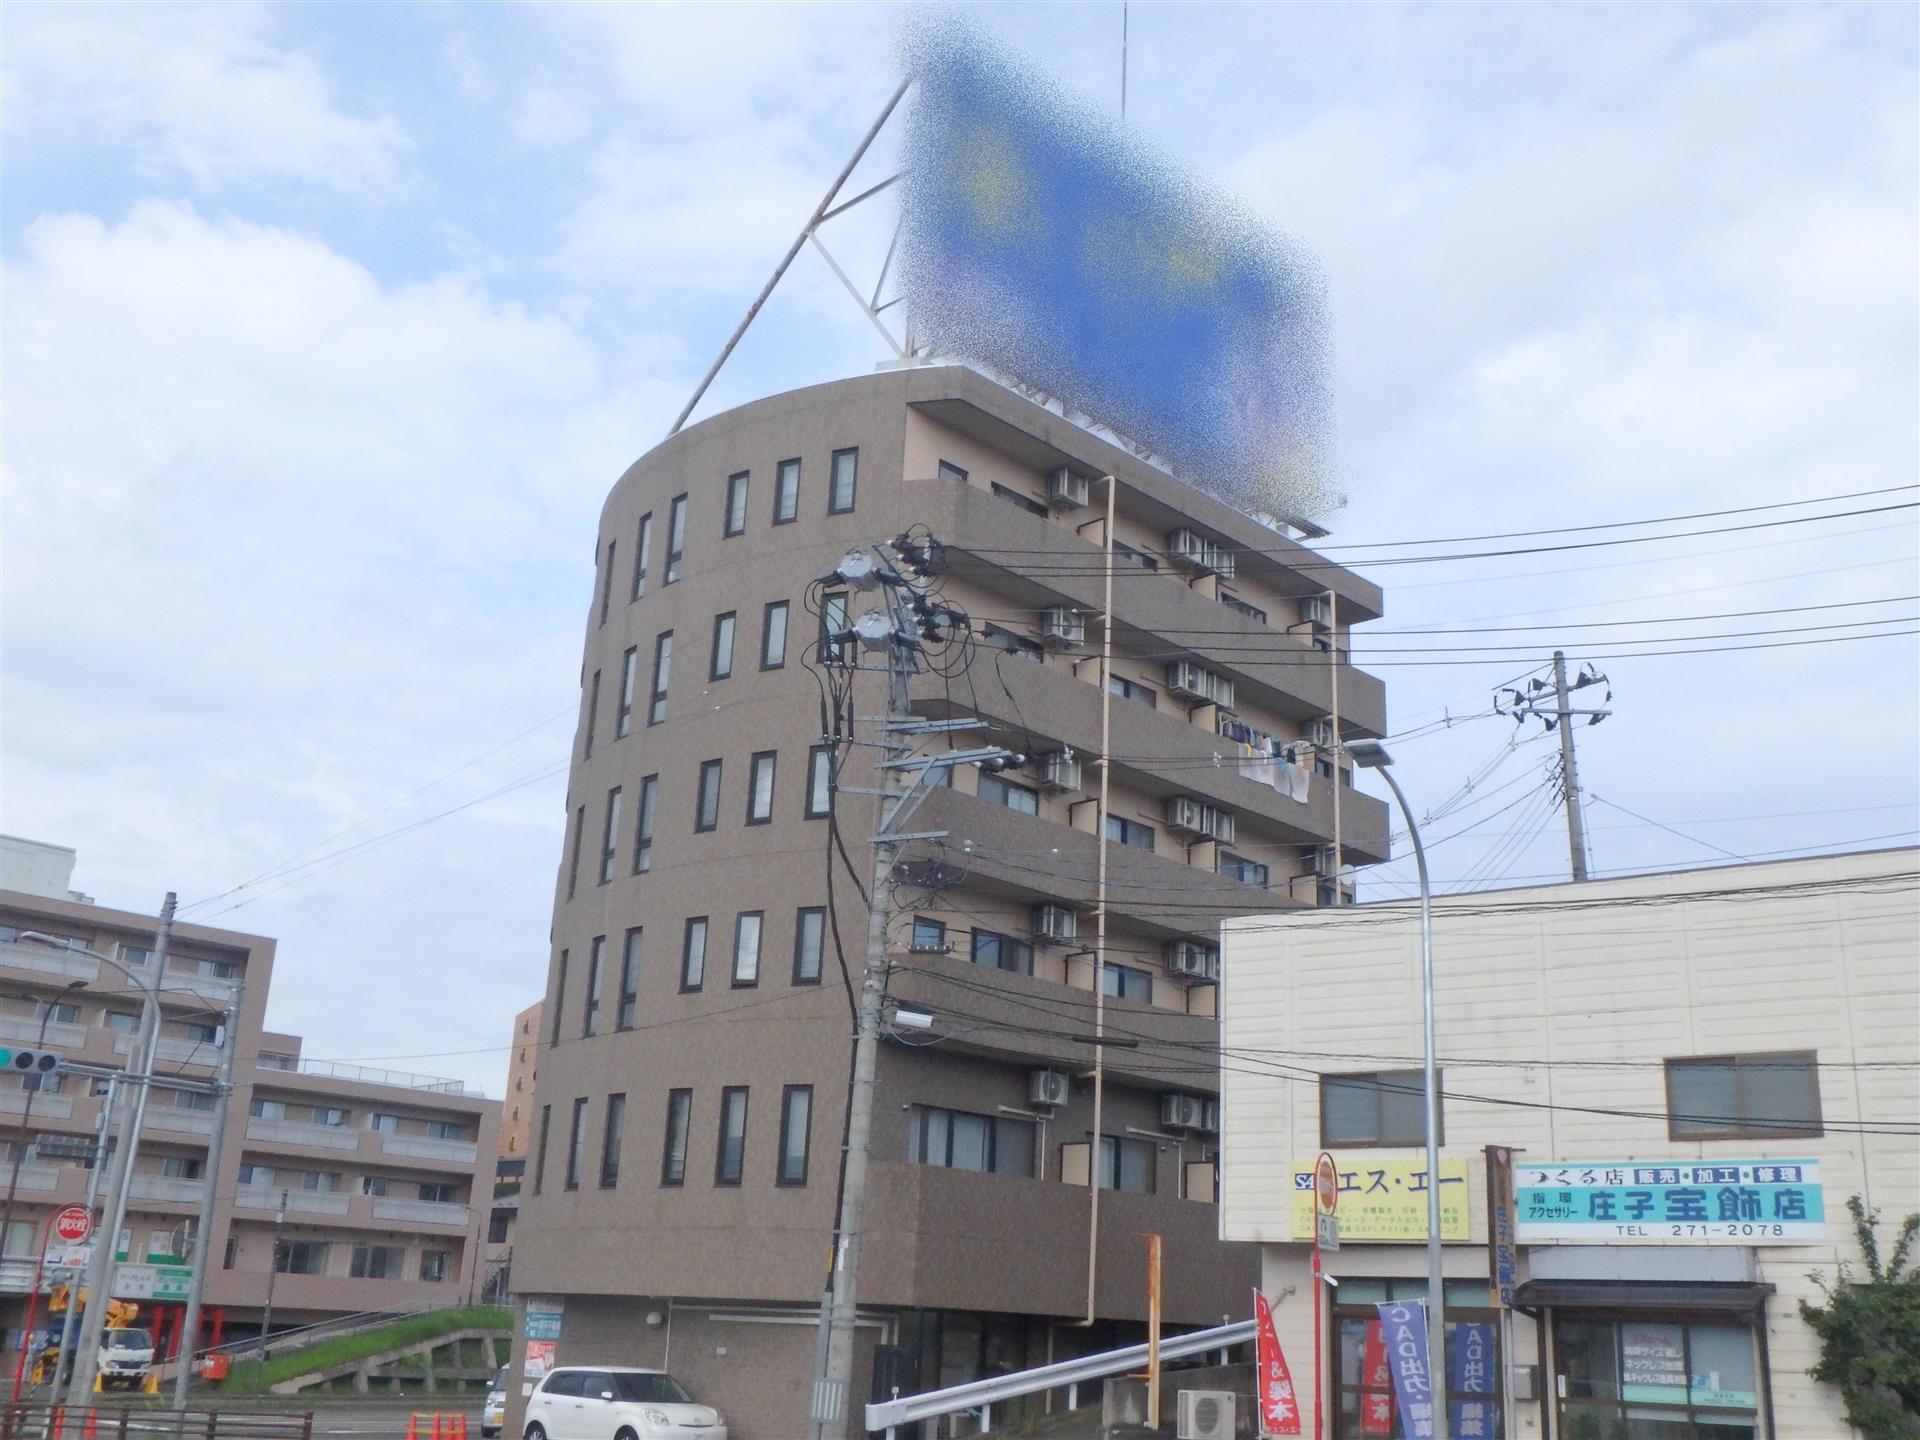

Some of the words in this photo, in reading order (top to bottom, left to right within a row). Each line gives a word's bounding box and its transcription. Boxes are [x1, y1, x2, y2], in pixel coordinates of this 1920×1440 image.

[1530, 1168, 1624, 1185] つくる店
[1588, 1186, 1806, 1221] 庄子宝飾店
[1528, 1206, 1578, 1218] アクセサリー
[59, 1217, 87, 1232] 消火栓
[1616, 1226, 1648, 1236] TEL
[1672, 1224, 1784, 1236] 271-2078
